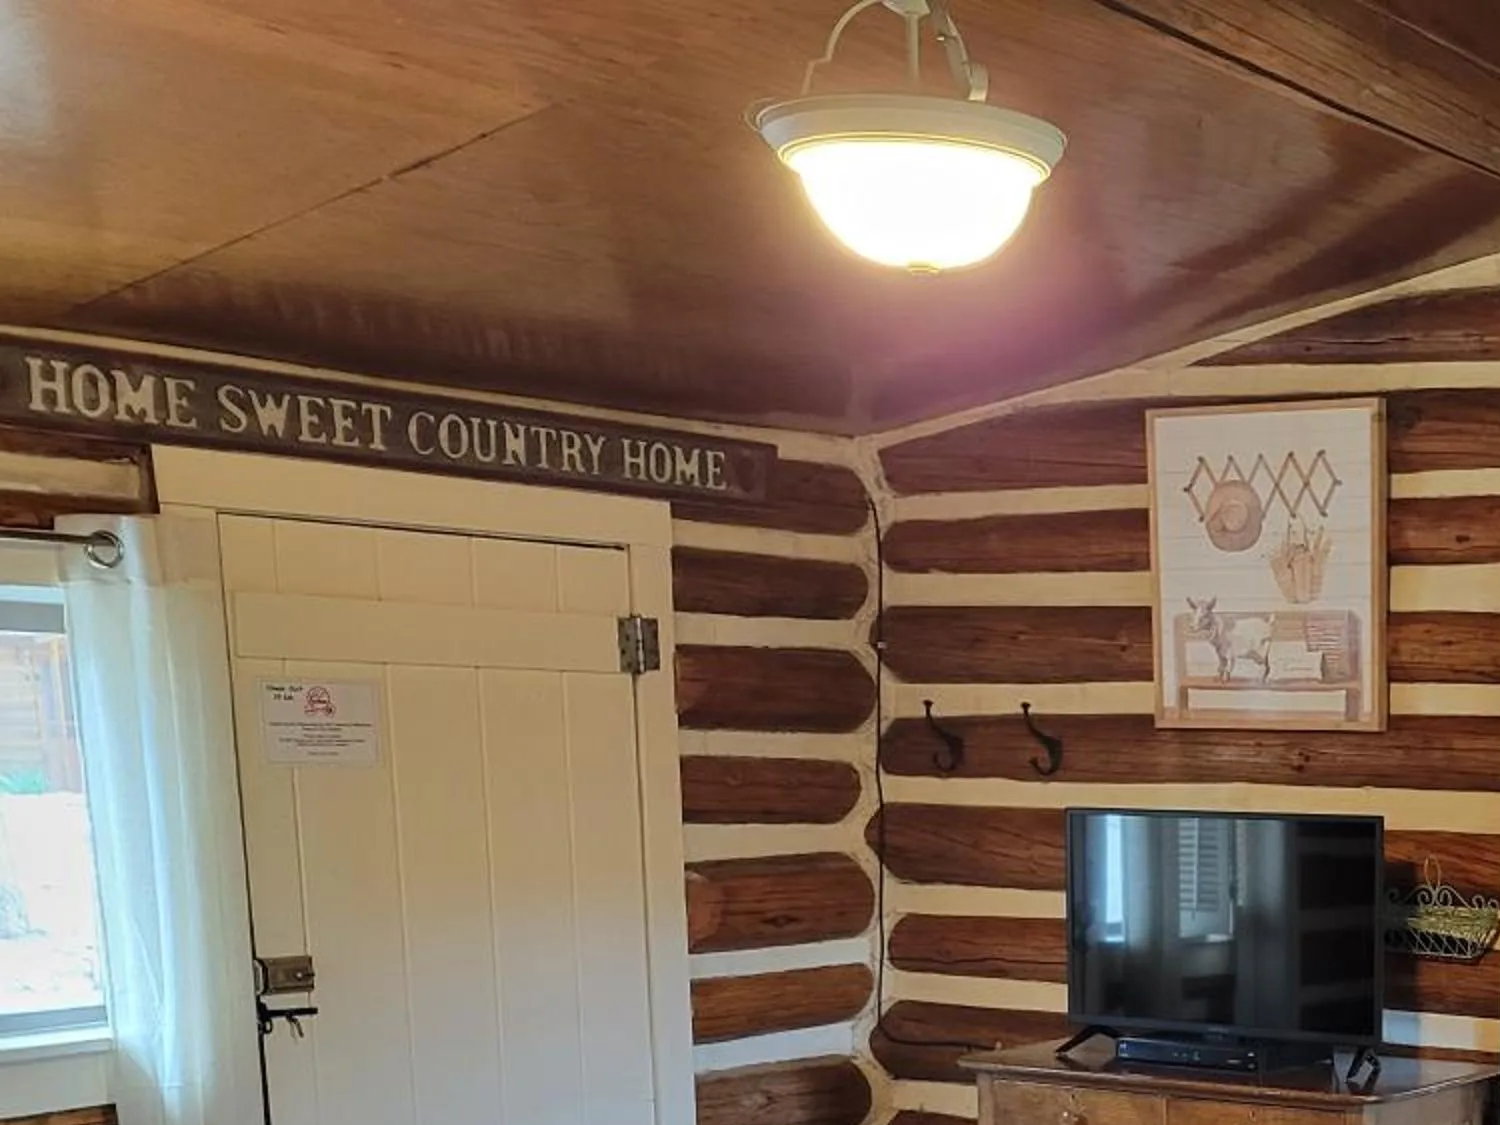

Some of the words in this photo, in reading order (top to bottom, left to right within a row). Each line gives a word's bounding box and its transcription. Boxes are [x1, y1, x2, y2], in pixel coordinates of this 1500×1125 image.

[24, 356, 198, 428] HOME
[216, 383, 392, 450] SWEET
[407, 411, 607, 475] COUNTRY
[621, 438, 728, 490] HOME
